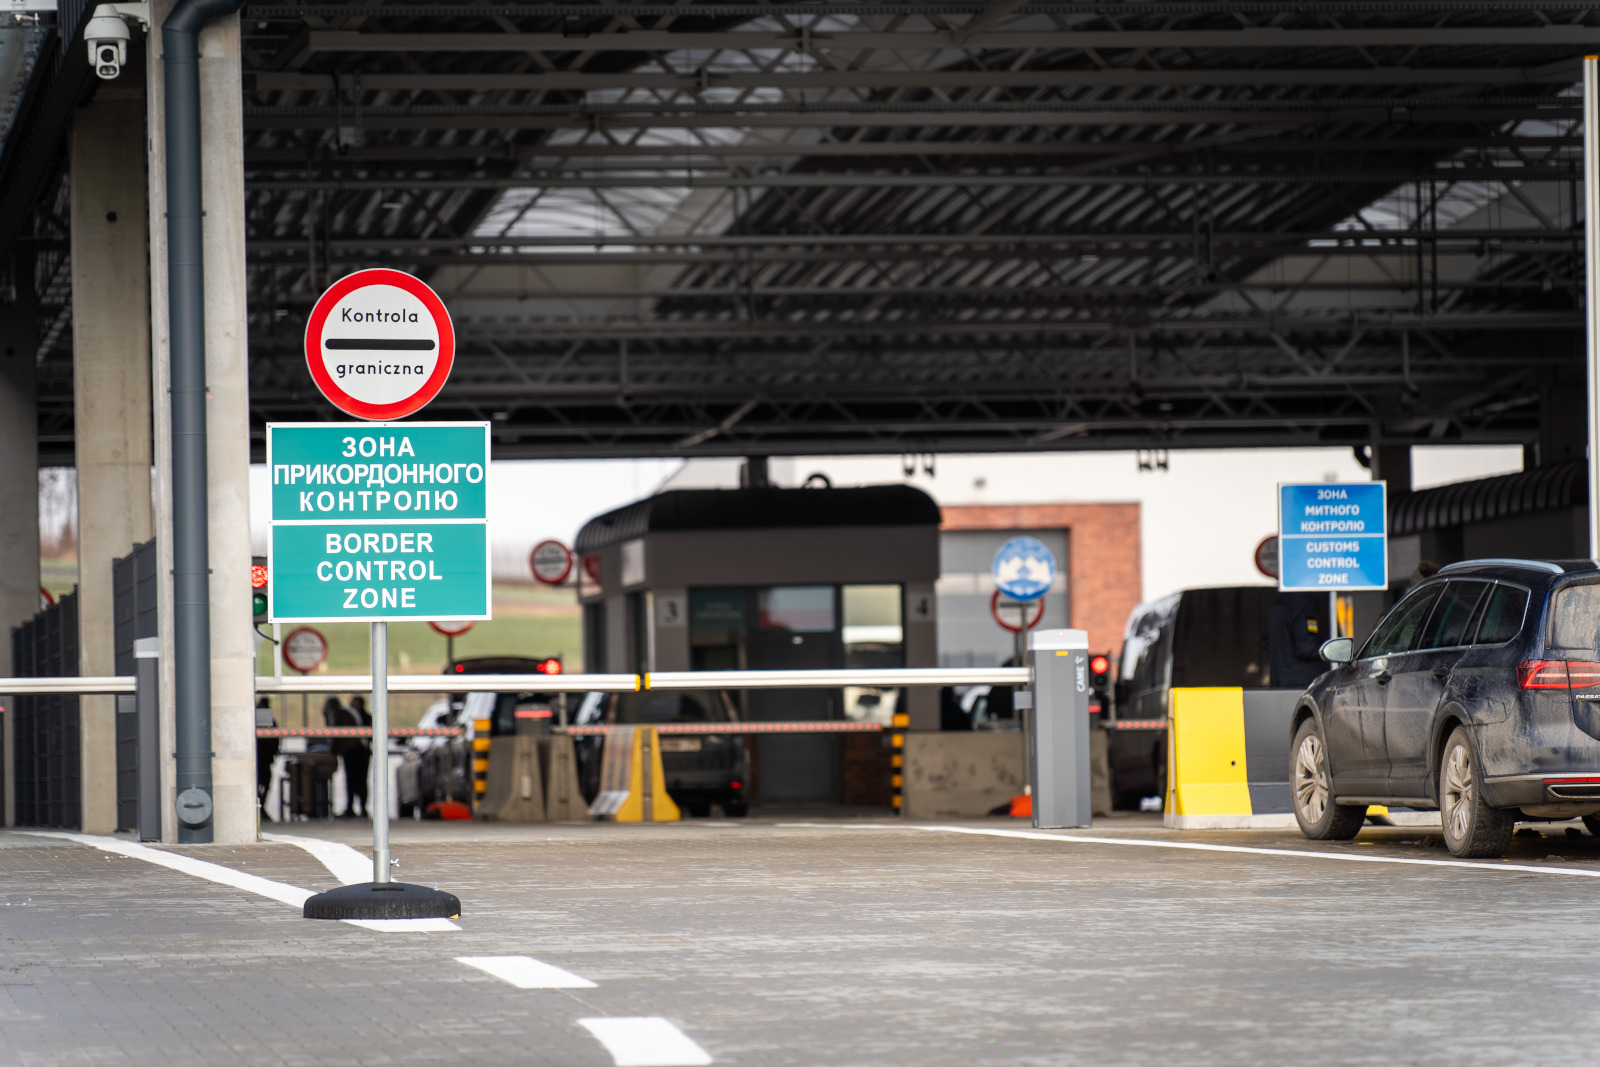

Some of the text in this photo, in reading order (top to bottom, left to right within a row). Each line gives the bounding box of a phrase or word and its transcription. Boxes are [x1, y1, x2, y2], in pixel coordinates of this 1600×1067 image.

[341, 307, 419, 323] Kontrola
[336, 360, 424, 378] graniczna
[341, 436, 416, 458] ЗОНА
[273, 463, 484, 488] ПРИКОРДОННОГО
[299, 490, 459, 512] КОНТРОЛЮ
[1317, 489, 1348, 500] ЗОНА
[1304, 504, 1360, 516] МИТНОГО
[1300, 520, 1365, 532] КОНТРОЛЮ
[325, 532, 434, 554] BORDER
[1305, 541, 1360, 553] CUSTOMS
[316, 559, 443, 582] CONTROL
[1306, 557, 1360, 569] CONTROL
[1317, 573, 1349, 585] ZONE
[342, 587, 417, 609] ZONE
[1076, 666, 1085, 692] CAME
